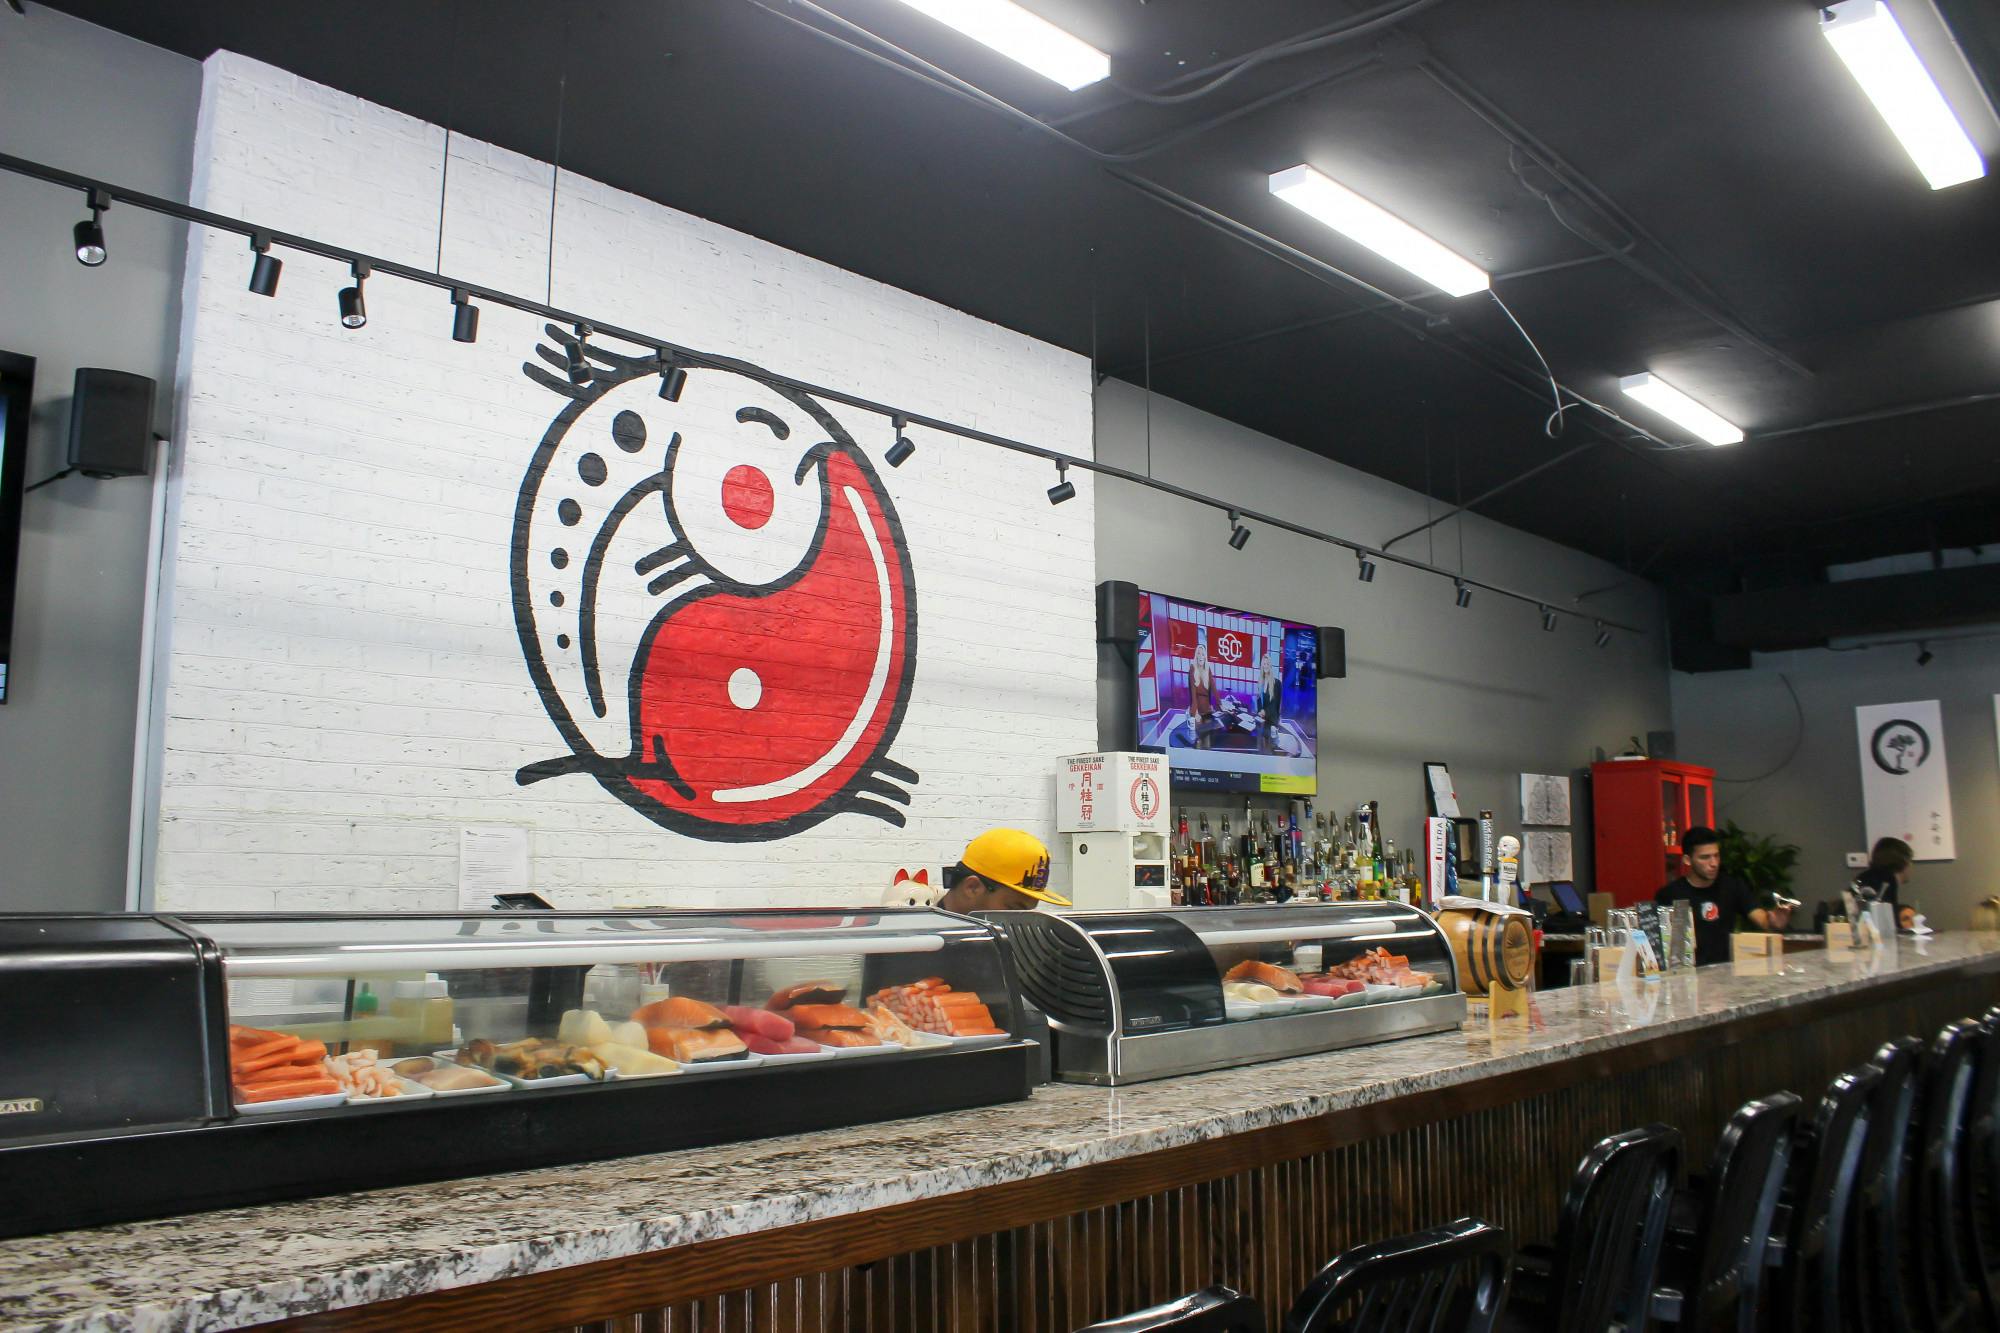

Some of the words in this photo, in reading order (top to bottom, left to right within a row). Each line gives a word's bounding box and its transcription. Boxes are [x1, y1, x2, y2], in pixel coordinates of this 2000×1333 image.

[1149, 757, 1160, 765] SAKE
[1070, 763, 1102, 772] GEKKEIKAN
[1130, 762, 1158, 772] GEKKEIKAN
[1080, 772, 1093, 821] 月桂冠
[1436, 822, 1444, 854] ULTRA
